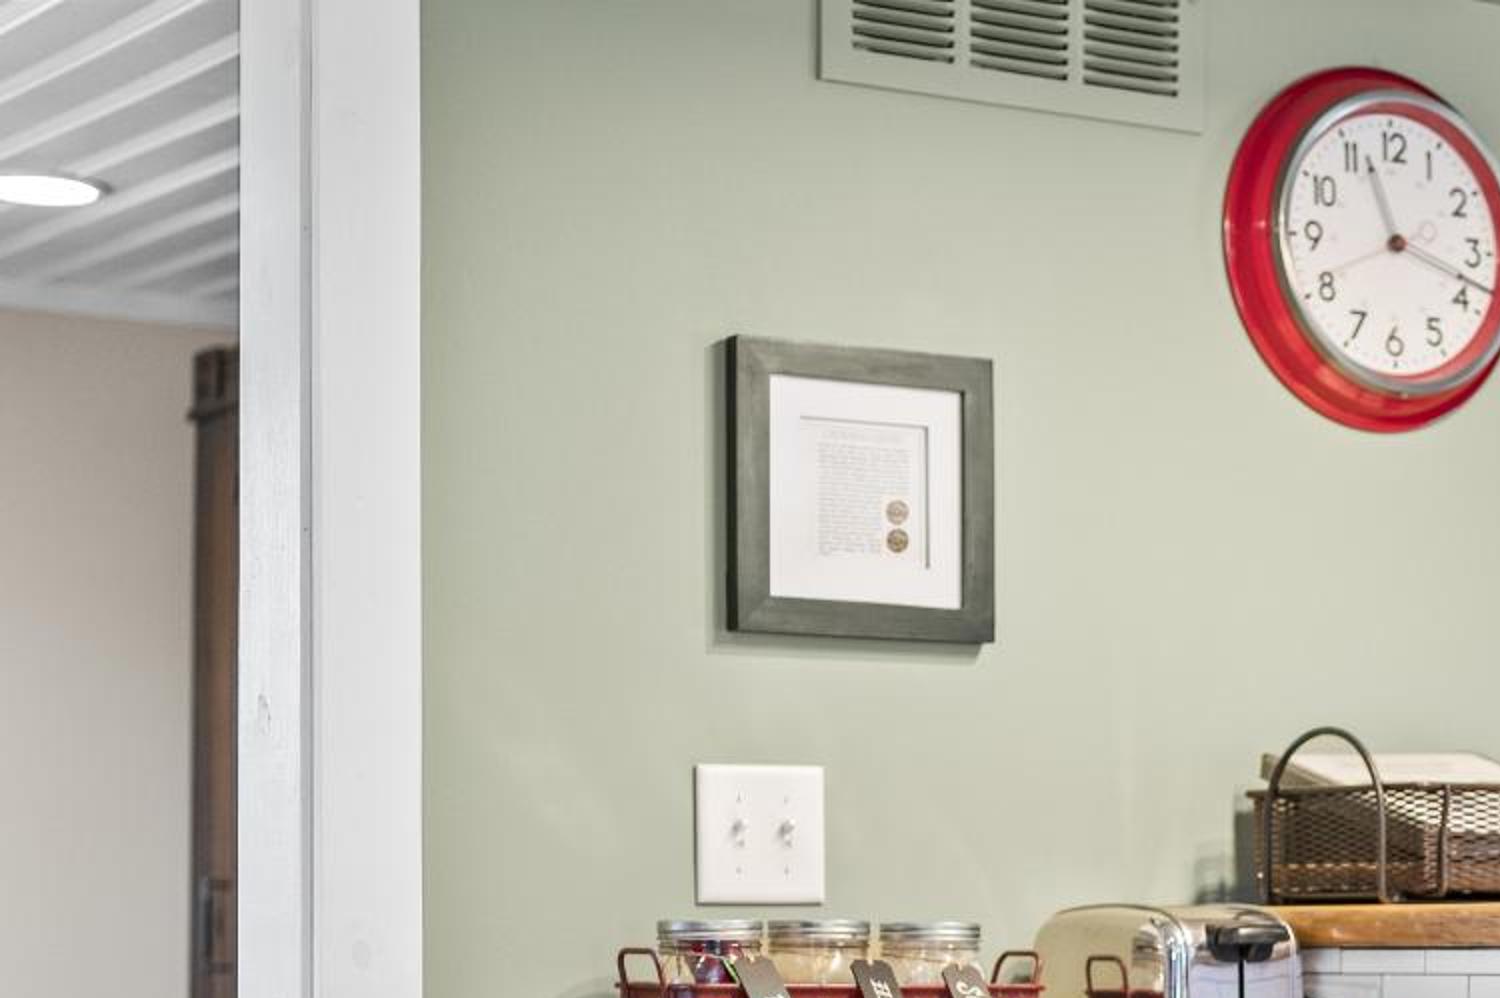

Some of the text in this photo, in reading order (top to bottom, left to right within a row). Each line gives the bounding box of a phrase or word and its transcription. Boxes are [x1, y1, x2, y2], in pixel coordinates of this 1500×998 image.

[1344, 141, 1358, 173] 11
[1381, 132, 1408, 164] 12
[1425, 151, 1432, 182] 1
[1312, 175, 1337, 207] 10
[1449, 188, 1468, 218] 2
[1304, 220, 1324, 251] 9
[1464, 238, 1482, 269] 3
[1318, 271, 1336, 302] 8
[1452, 283, 1470, 312] 4
[1349, 310, 1368, 340] 7
[1426, 317, 1444, 347] 5
[1385, 326, 1405, 358] 6
